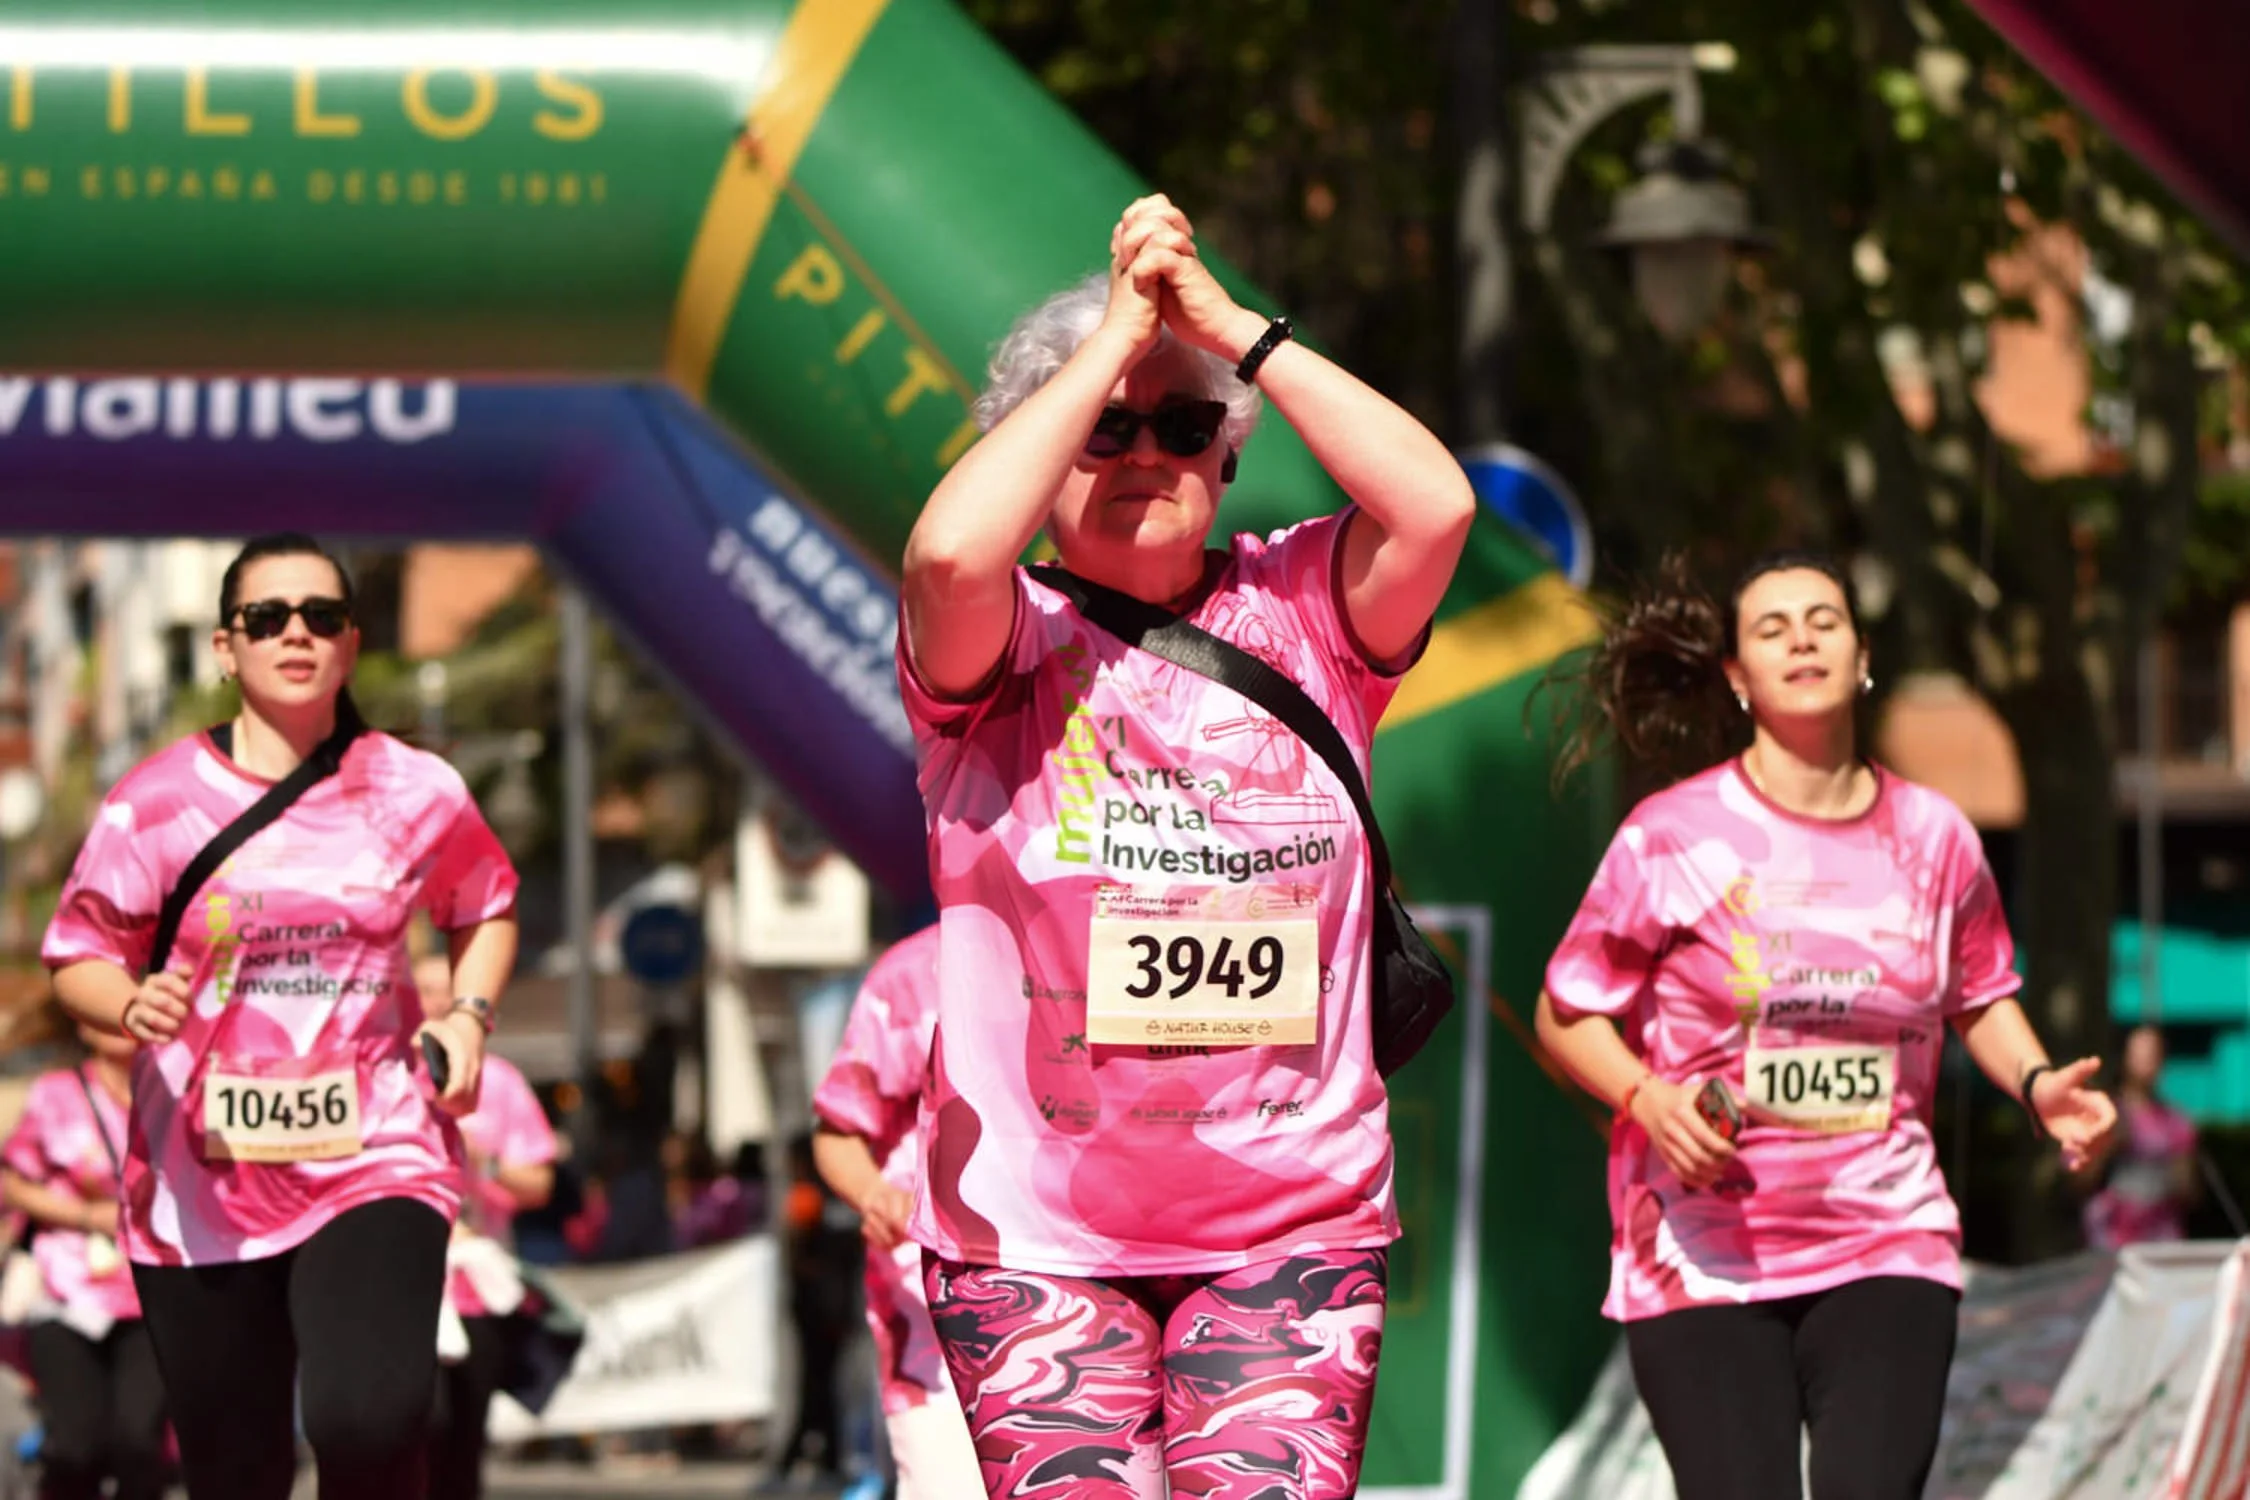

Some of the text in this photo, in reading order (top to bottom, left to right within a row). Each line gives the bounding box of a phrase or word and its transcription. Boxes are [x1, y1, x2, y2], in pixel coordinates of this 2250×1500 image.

[81, 163, 276, 200] ESPAÑA
[309, 170, 467, 205] DESDE
[1103, 798, 1207, 831] por la
[1102, 832, 1337, 884] Investigación
[239, 896, 263, 912] XI
[239, 923, 342, 943] Carrera
[1768, 932, 1791, 952] XI
[241, 948, 310, 969] por la
[1125, 935, 1284, 999] 3949
[1768, 963, 1876, 986] Carrera
[1766, 994, 1845, 1025] por la
[1759, 1057, 1880, 1103] 10455
[218, 1084, 348, 1130] 10456
